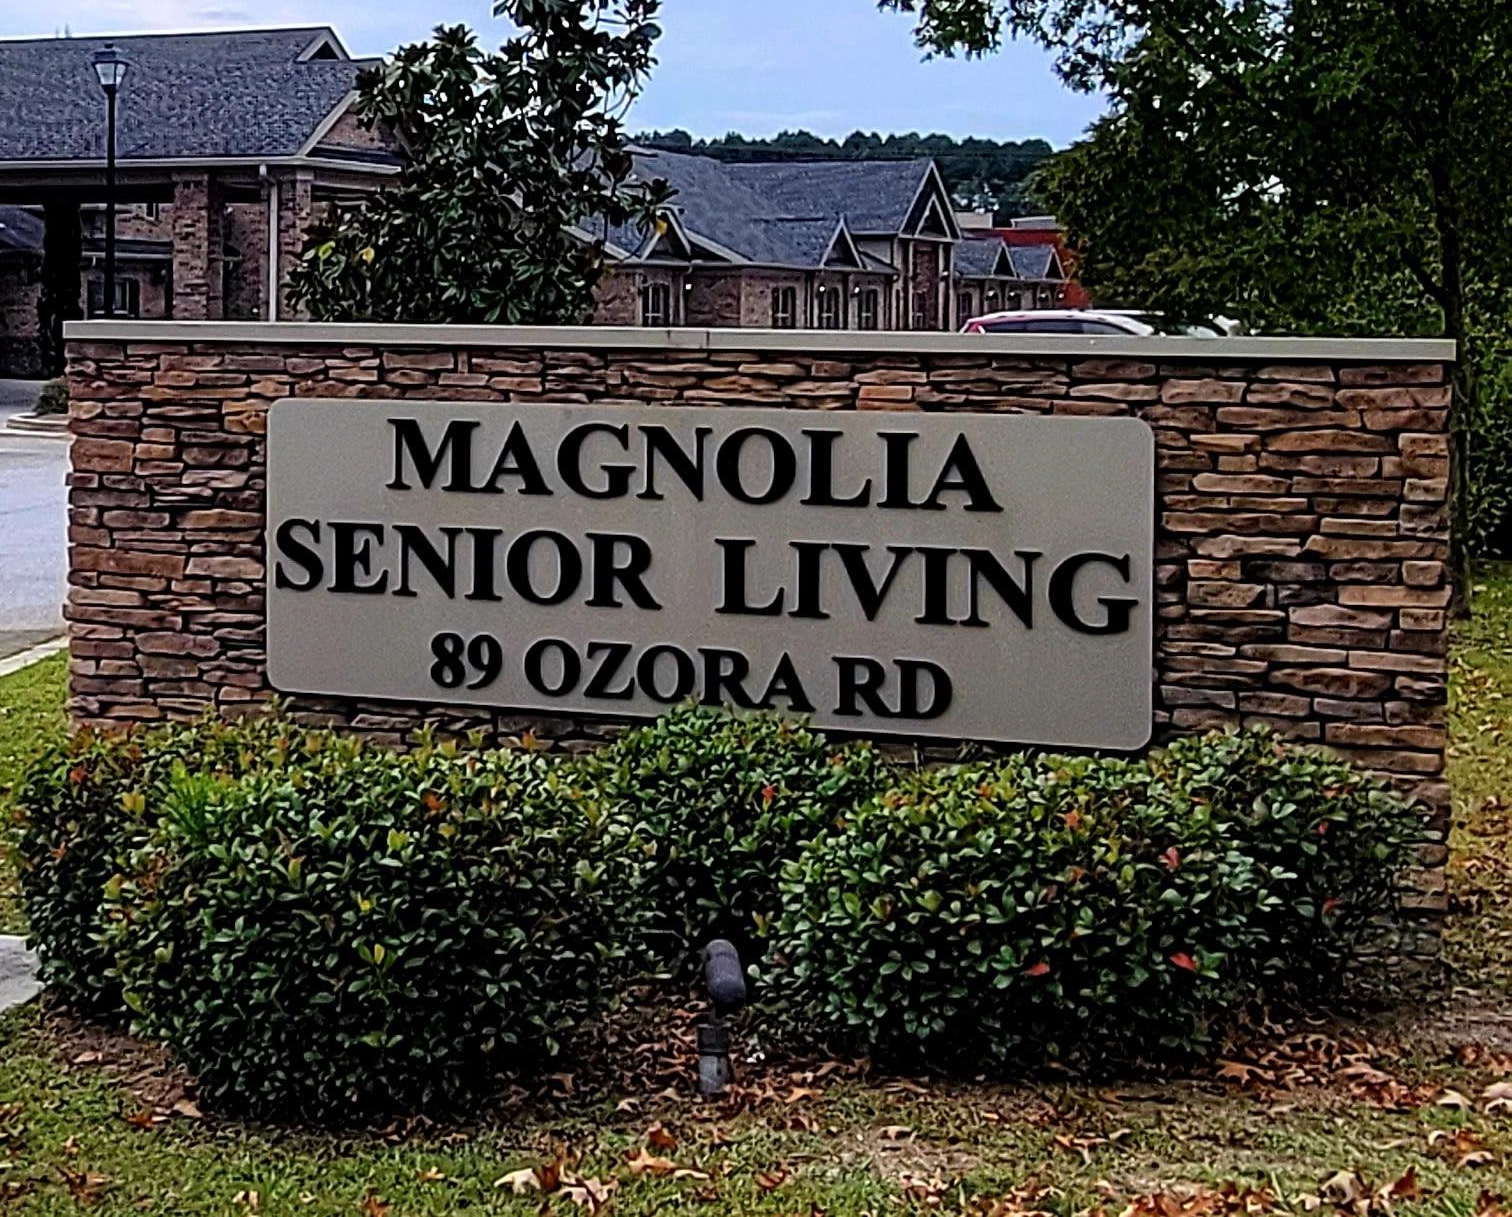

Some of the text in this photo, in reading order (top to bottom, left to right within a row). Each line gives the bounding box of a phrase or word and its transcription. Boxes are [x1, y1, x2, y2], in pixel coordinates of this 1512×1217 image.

[385, 418, 1004, 515] MAGNOLIA
[274, 518, 1141, 639] SENIOR LIVING
[430, 632, 955, 721] 89 OZORA RD
